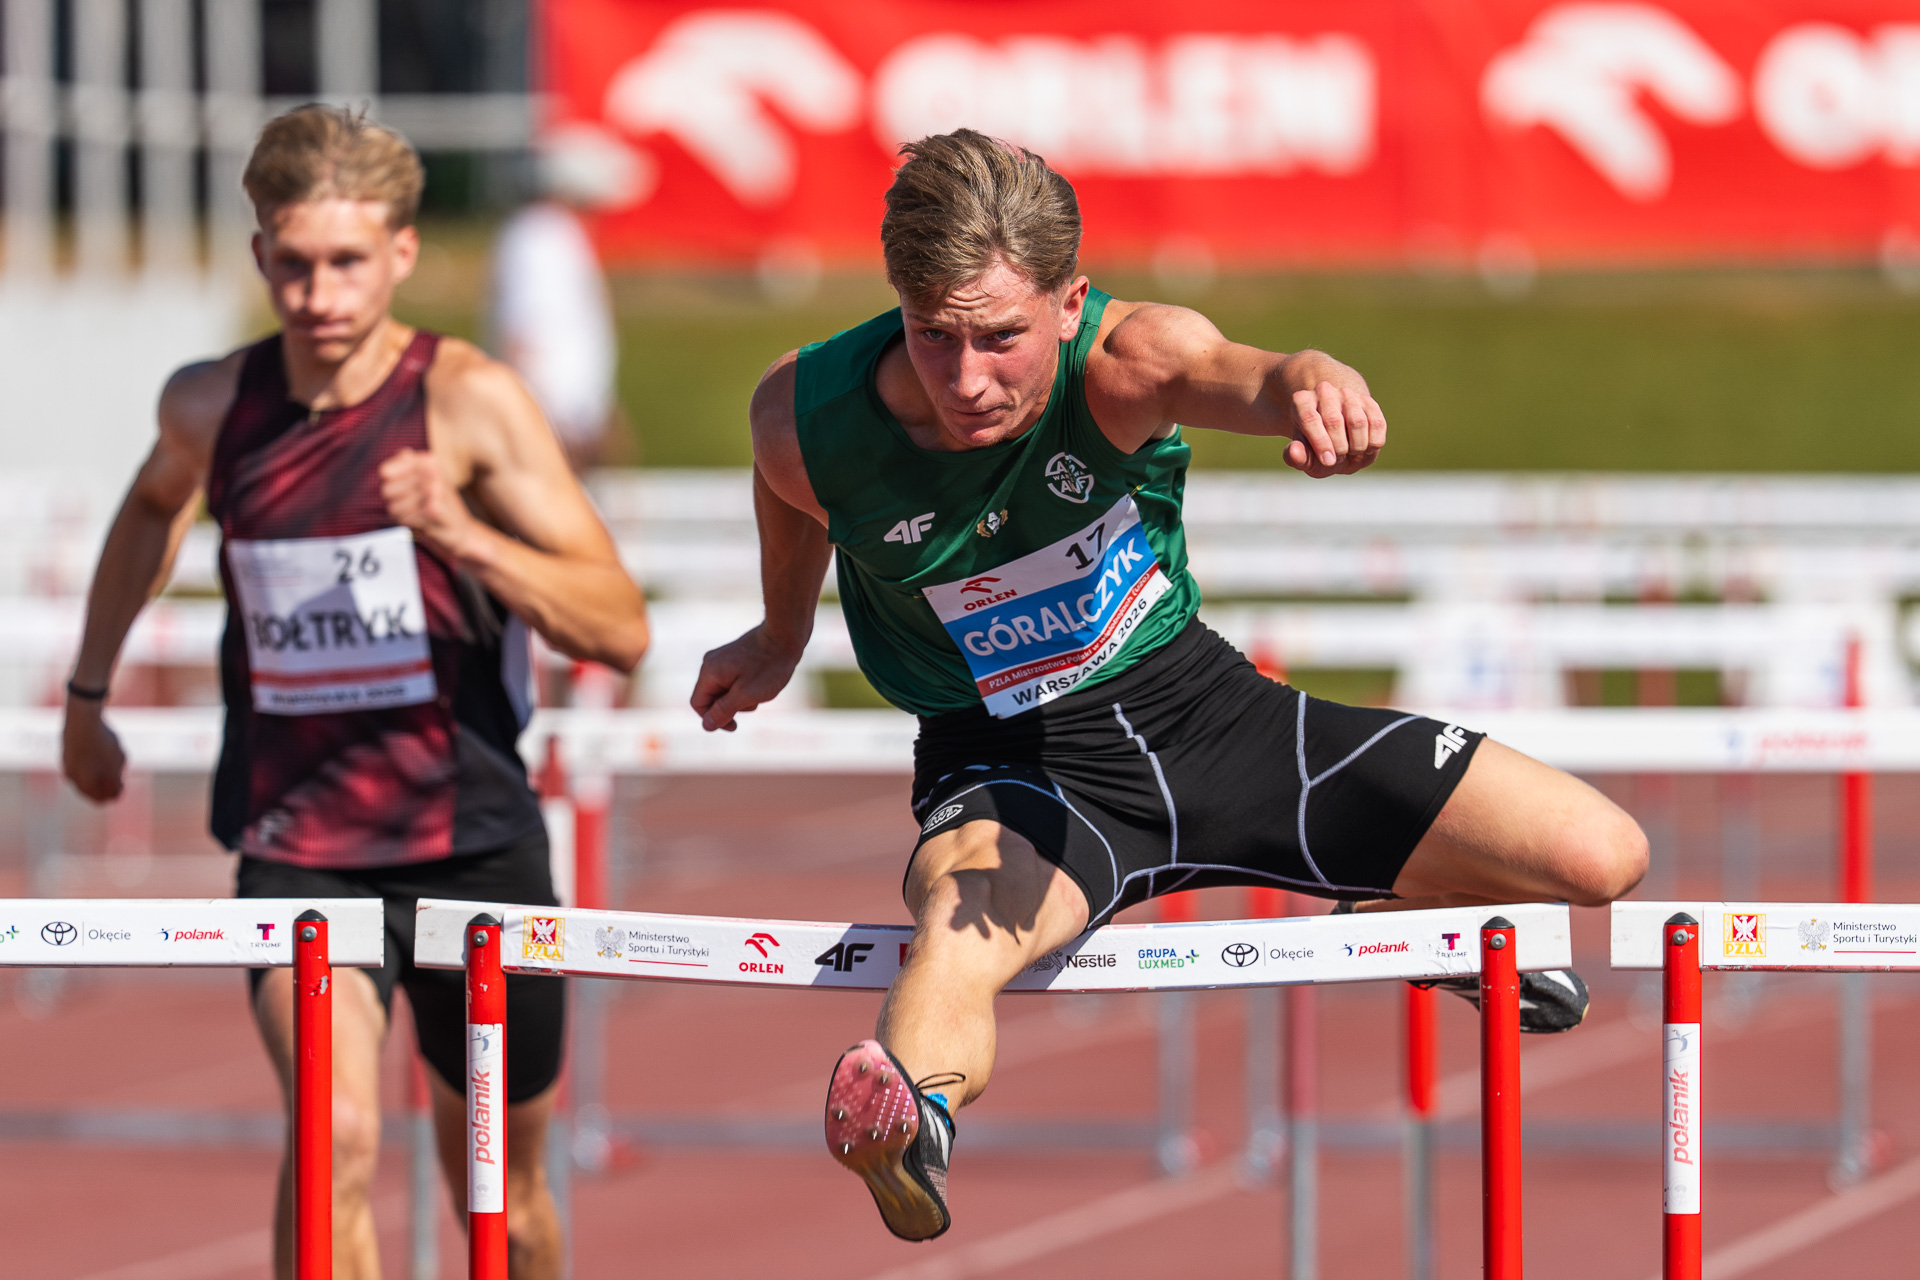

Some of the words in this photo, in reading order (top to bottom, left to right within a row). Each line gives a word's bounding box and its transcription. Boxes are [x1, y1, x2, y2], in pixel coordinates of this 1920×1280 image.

[883, 512, 935, 544] 4F
[1065, 523, 1106, 570] 17
[333, 550, 380, 584] 26
[963, 538, 1143, 656] GÓRALCZYK
[964, 589, 1017, 612] ORLEN
[1012, 642, 1118, 706] WARSZAWA
[1118, 598, 1147, 639] 2026
[989, 675, 1011, 688] PZLA
[1011, 660, 1066, 680] Mistrzostwa
[1066, 648, 1092, 664] Polski
[1434, 724, 1468, 770] 4F
[1833, 922, 1896, 932] Ministerstwo
[88, 929, 131, 942] Okęcie
[174, 928, 225, 942] polanik
[628, 930, 690, 944] Ministerstwo
[1833, 933, 1865, 944] Sportu
[1874, 933, 1917, 945] Turystyki
[525, 945, 561, 958] PZLA
[628, 942, 659, 954] Sportu
[661, 945, 665, 954] i
[667, 945, 710, 958] Turystyki
[1138, 948, 1177, 959] GRUPA
[1270, 947, 1314, 961] Okęcie
[1358, 941, 1410, 957] polanik
[1725, 943, 1764, 955] PZLA
[814, 942, 875, 973] 4F
[1066, 953, 1117, 968] Nestlé
[1138, 958, 1185, 969] LUXMED
[739, 962, 784, 975] ORLEN
